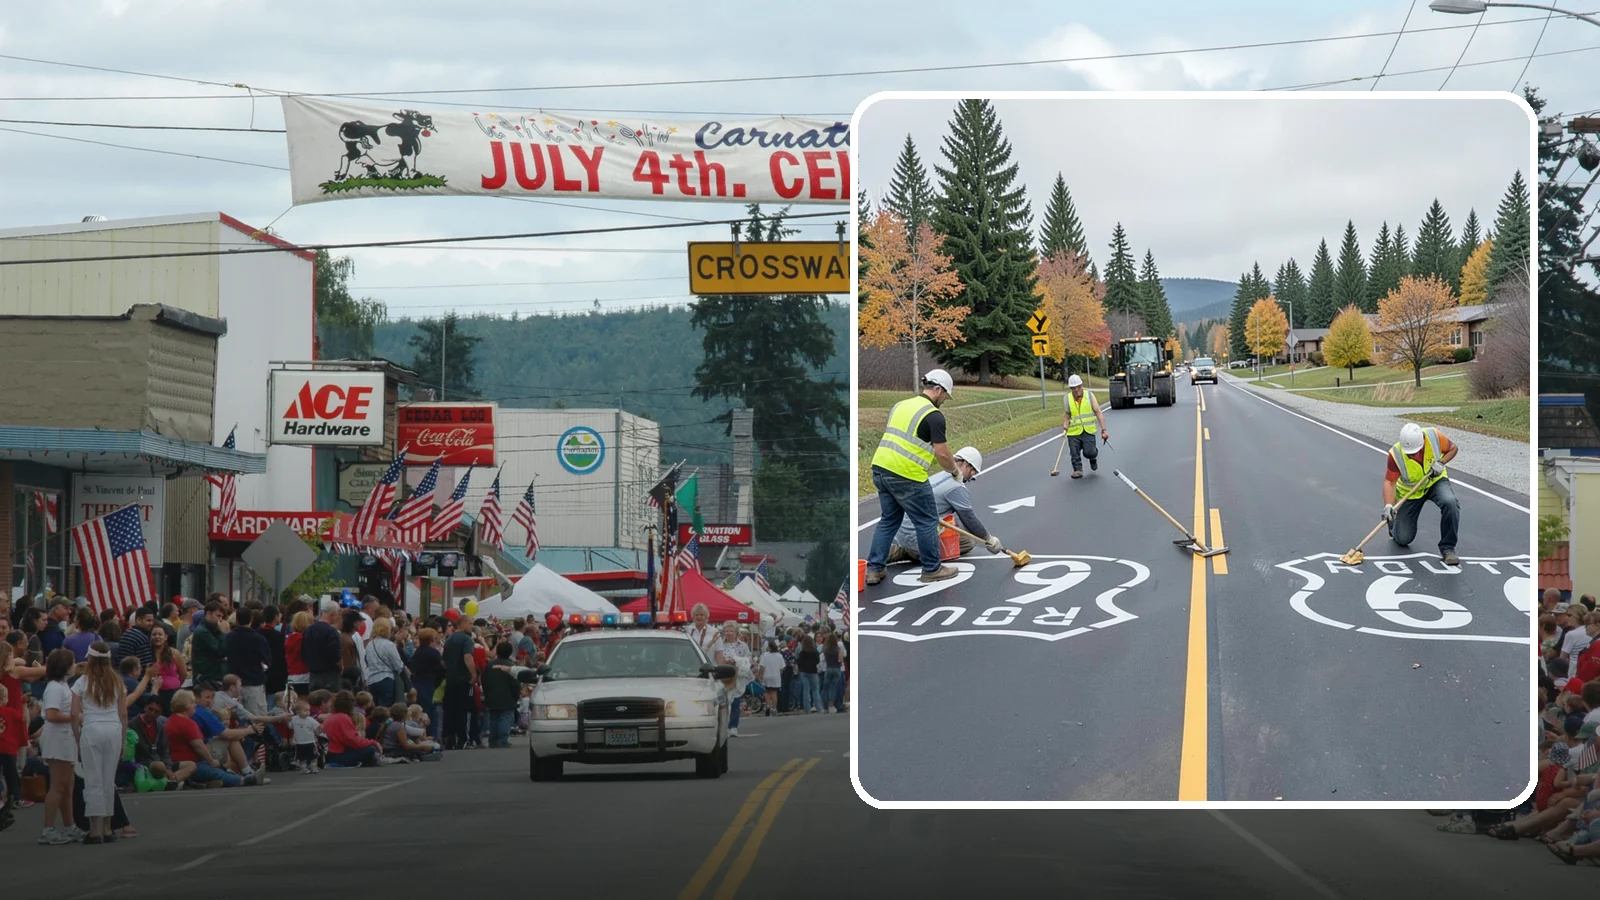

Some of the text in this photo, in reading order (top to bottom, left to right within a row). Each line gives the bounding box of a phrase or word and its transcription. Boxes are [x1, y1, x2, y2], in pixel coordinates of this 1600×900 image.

[481, 141, 605, 192] JULY
[632, 150, 747, 198] 4th.
[696, 254, 850, 281] CROSSWA
[283, 380, 374, 420] ACE
[406, 409, 453, 422] CEDAR
[283, 421, 371, 437] Hardware
[416, 428, 477, 447] Coca-Cola
[353, 467, 384, 480] Simpl
[96, 485, 124, 495] Vincent
[126, 486, 136, 495] de
[138, 486, 155, 495] Paul
[687, 526, 742, 535] CRNATION
[699, 535, 730, 543] GLASS
[1365, 575, 1530, 629] 6
[858, 606, 1082, 626] ROUT
